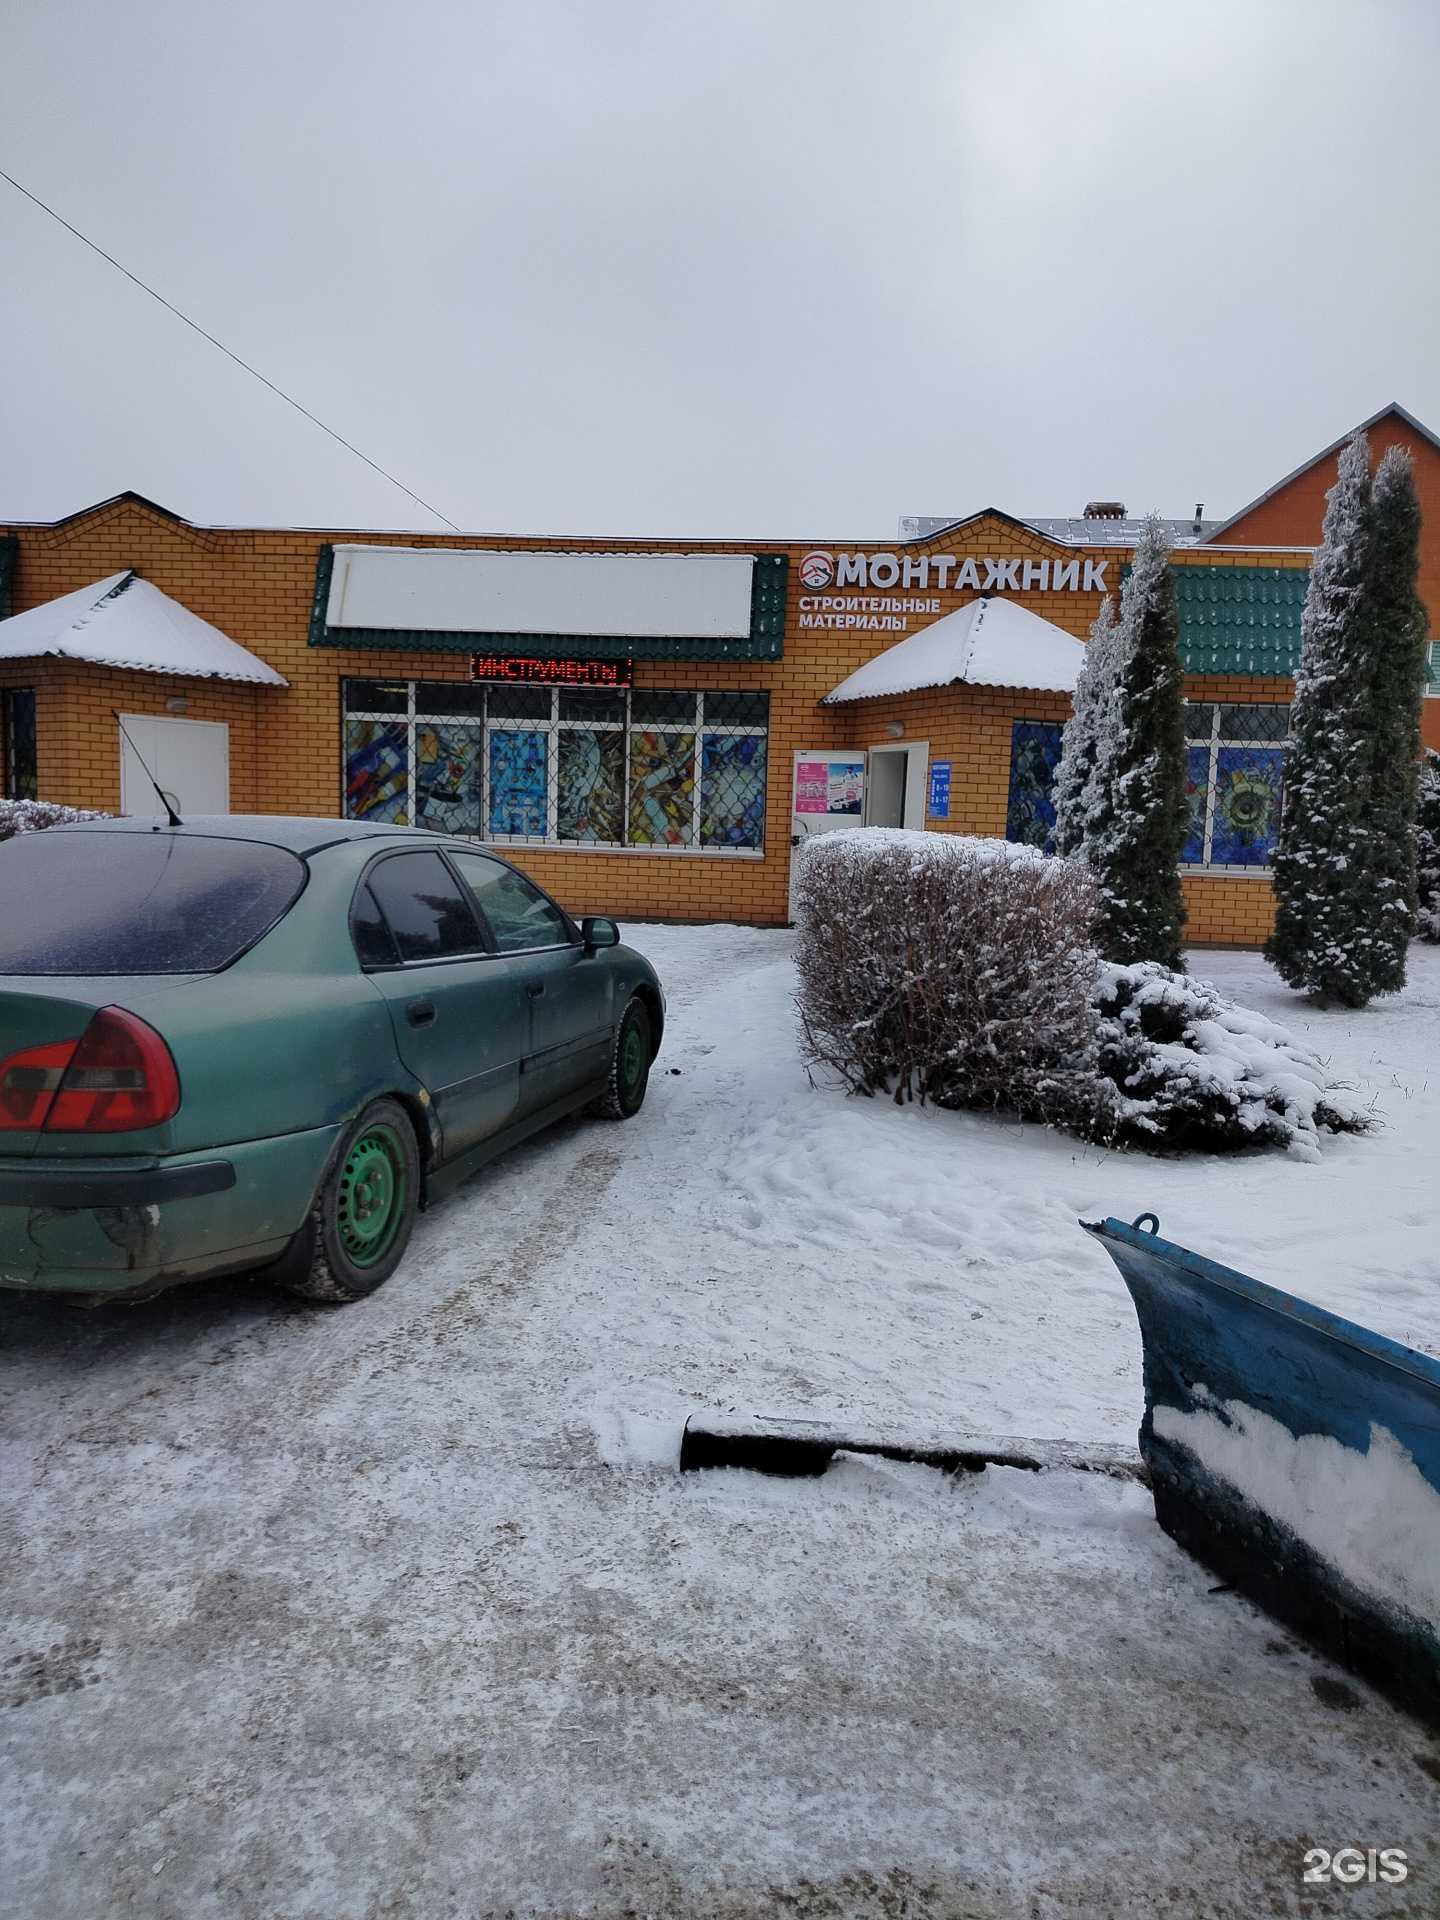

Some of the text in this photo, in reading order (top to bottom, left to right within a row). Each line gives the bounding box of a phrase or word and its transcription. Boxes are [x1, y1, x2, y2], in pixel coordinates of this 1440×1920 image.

[836, 553, 1110, 592] МОНТАЖНИК
[799, 596, 941, 613] СТРОИТЕЛЬНЫЕ
[799, 614, 907, 631] МАТЕРИАЛЫ
